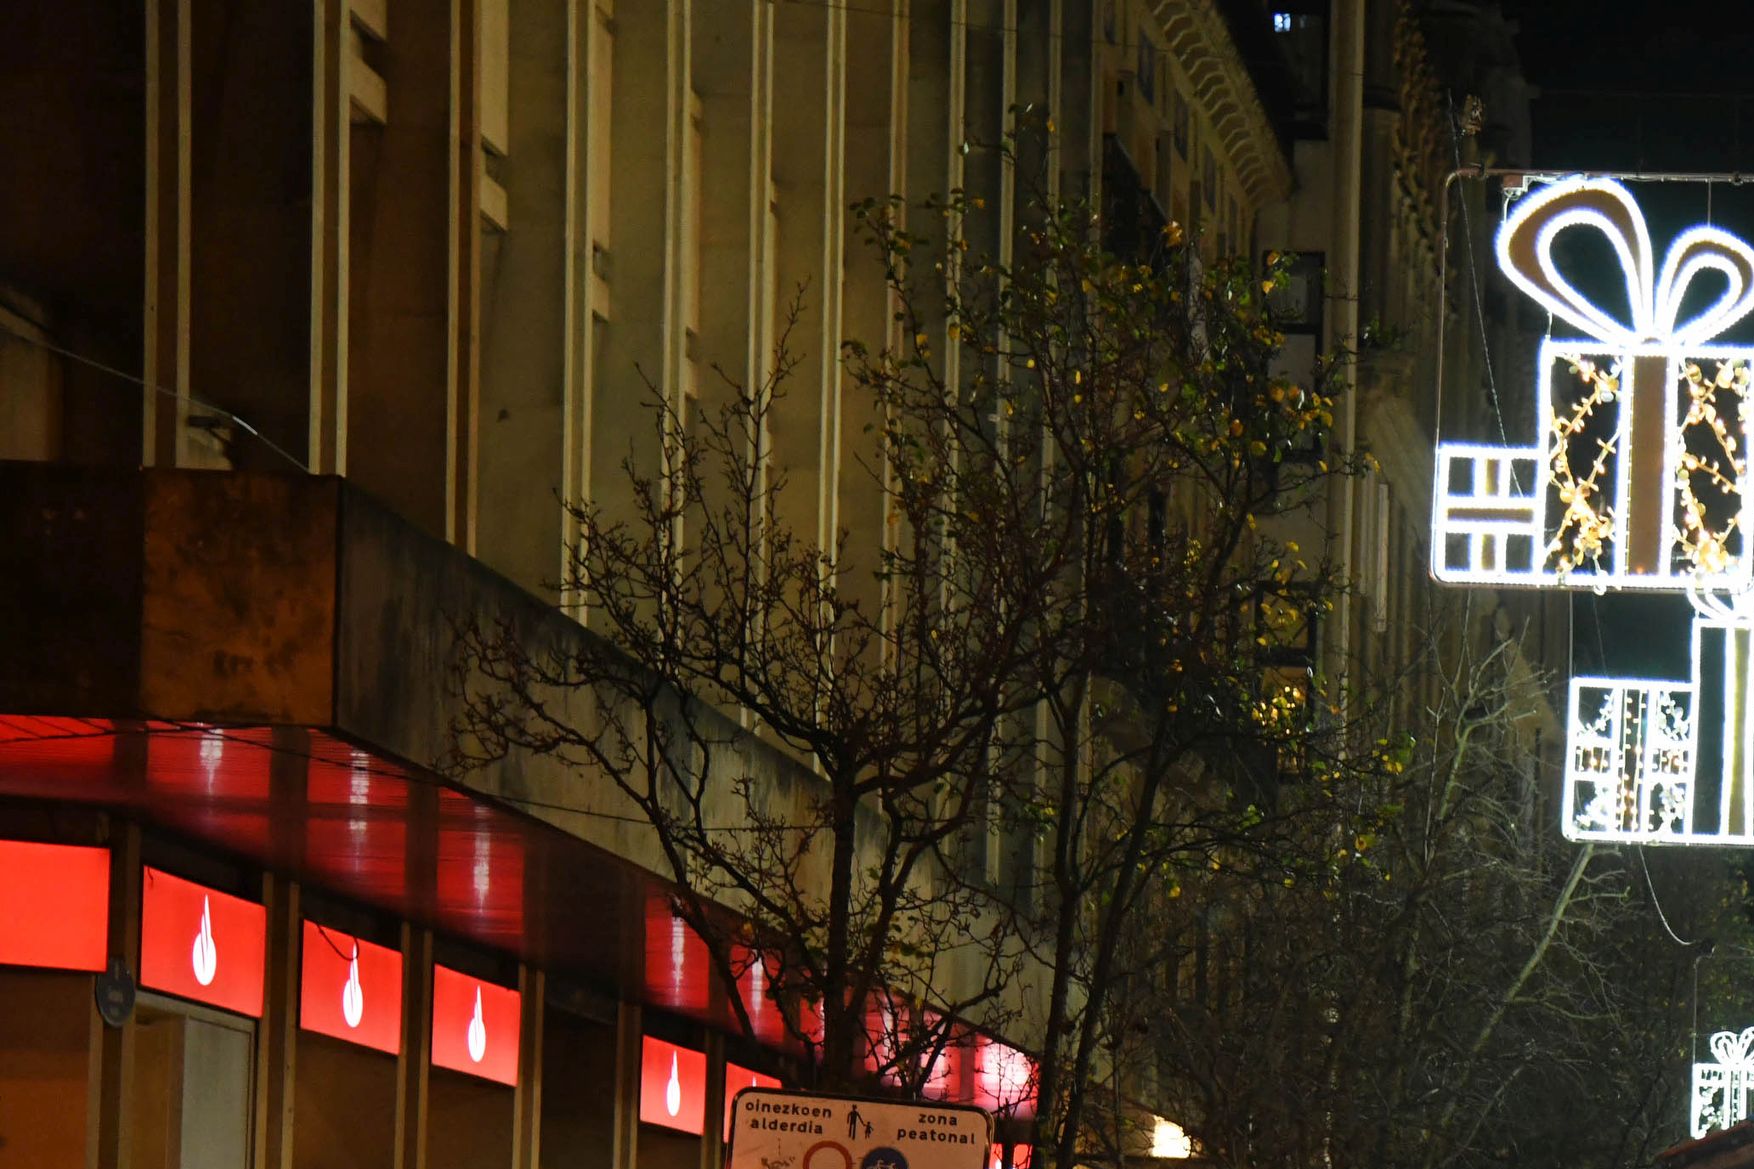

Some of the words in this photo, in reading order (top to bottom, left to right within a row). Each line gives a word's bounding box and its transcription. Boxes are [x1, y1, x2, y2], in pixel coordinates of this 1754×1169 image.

[745, 1099, 832, 1118] oinezkoen
[751, 1117, 823, 1135] alderdia
[918, 1113, 957, 1126] zona
[897, 1128, 975, 1145] peatonal
